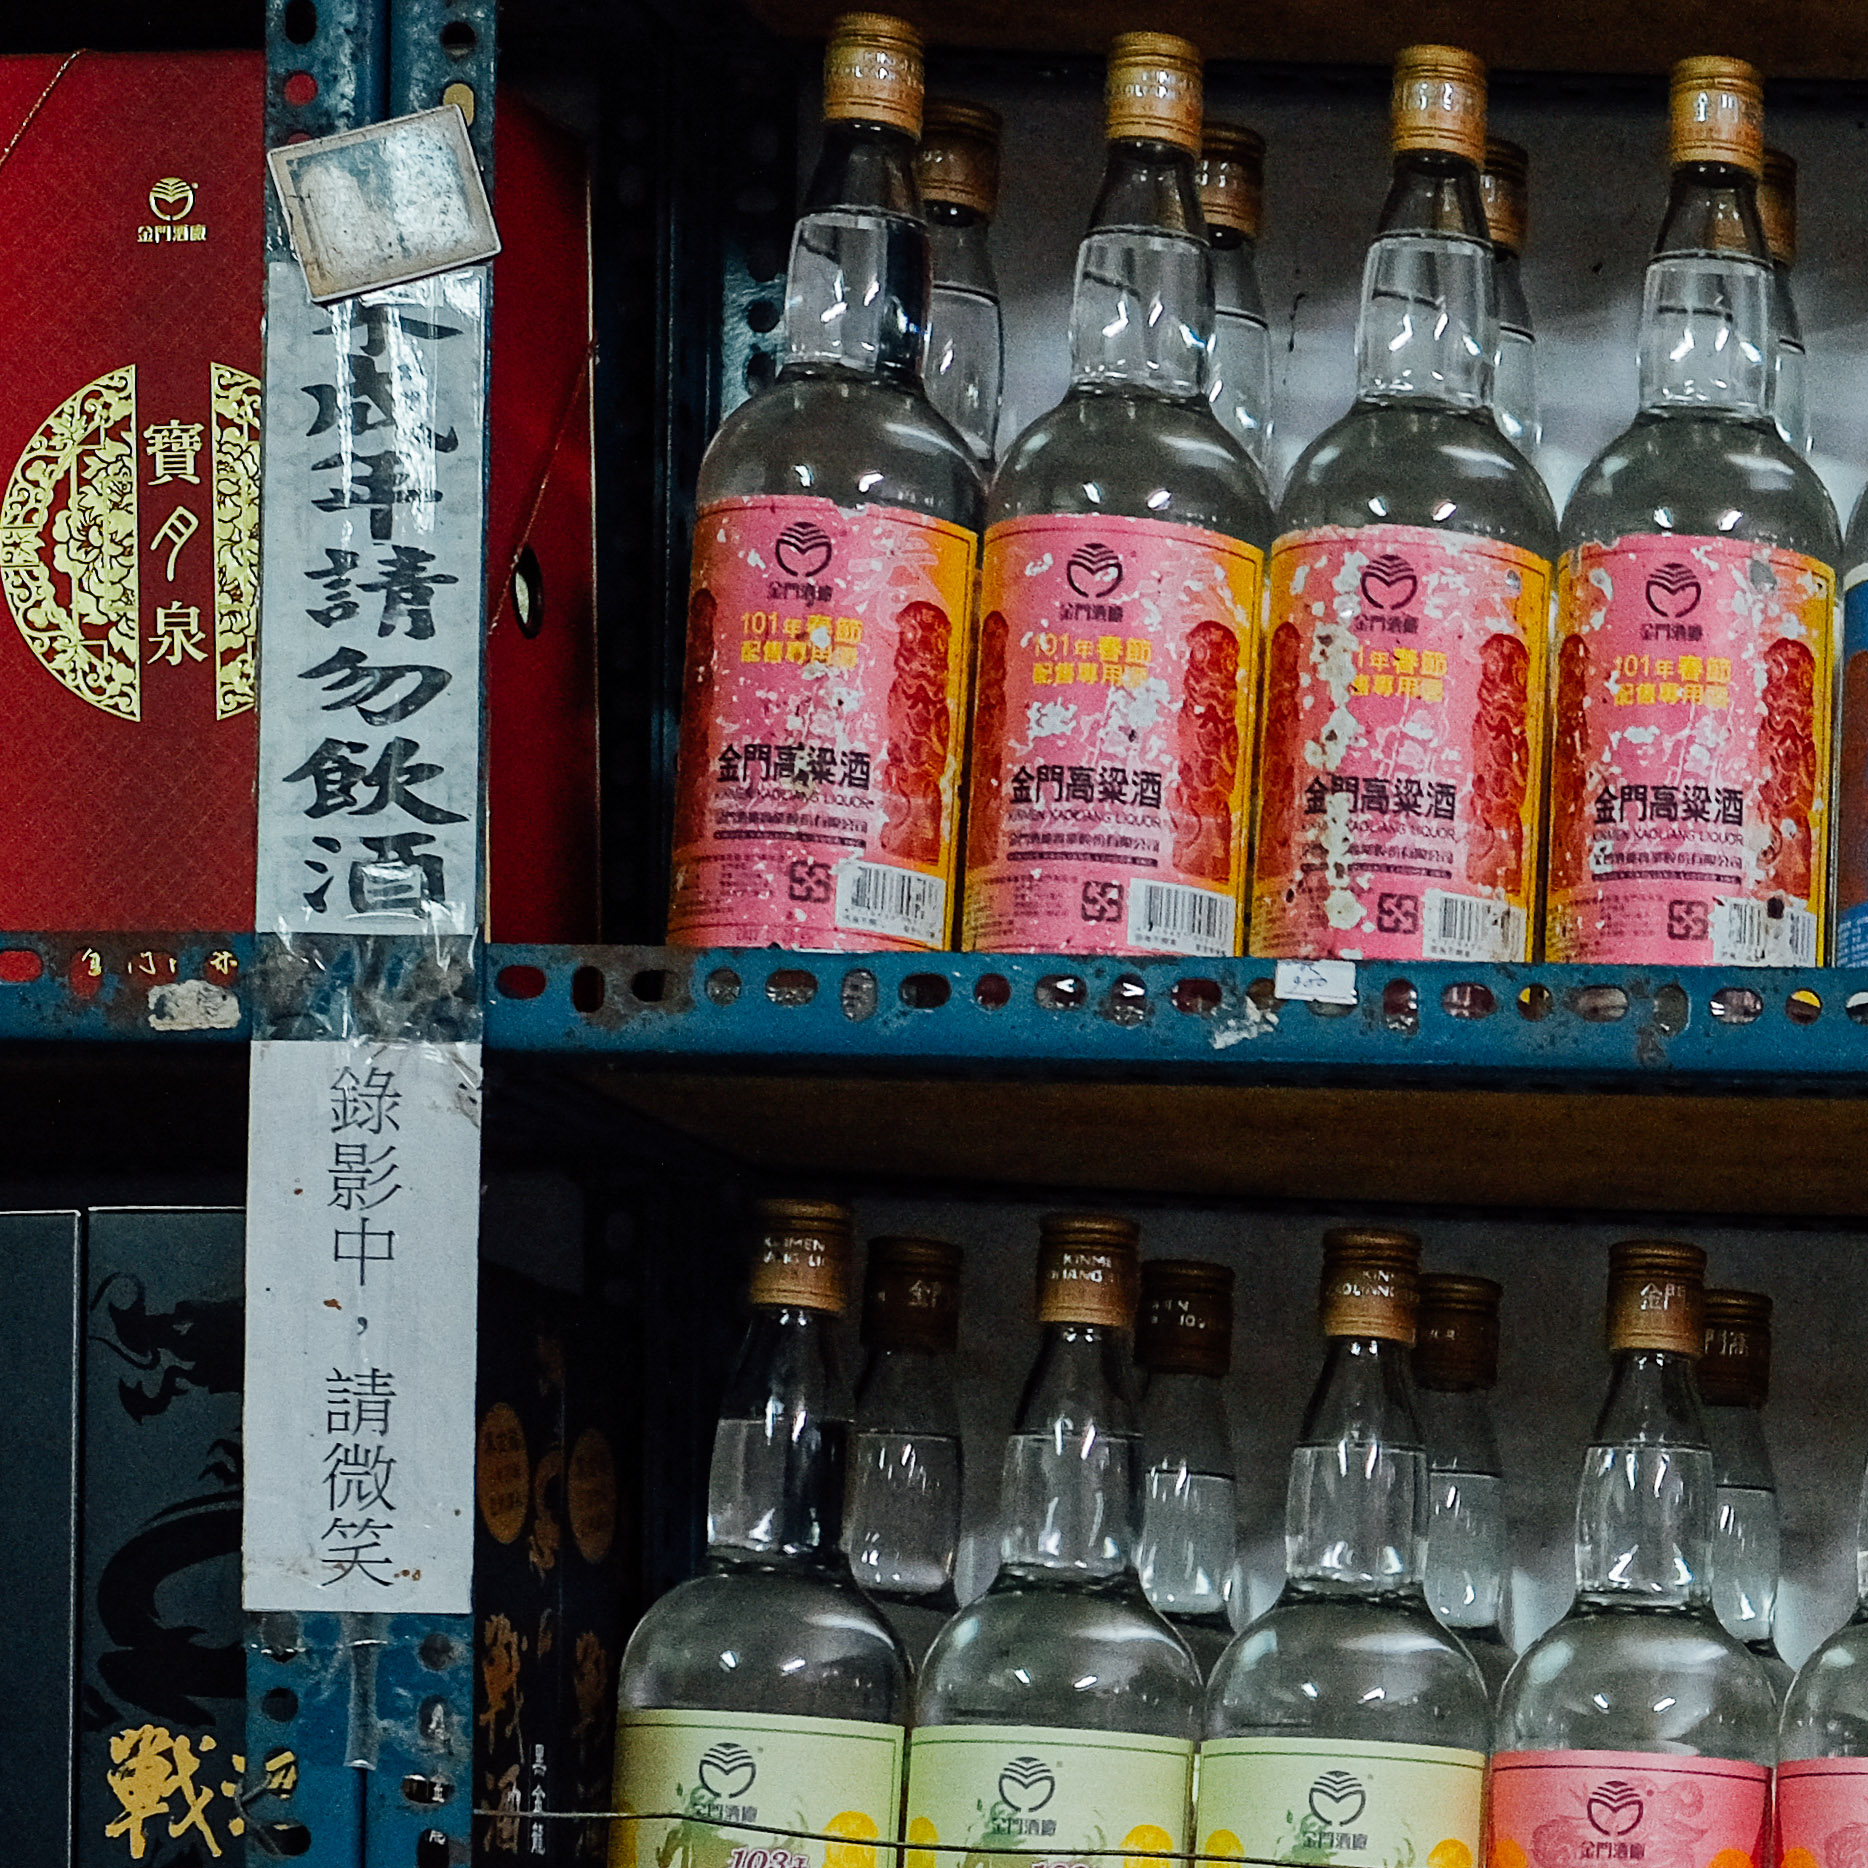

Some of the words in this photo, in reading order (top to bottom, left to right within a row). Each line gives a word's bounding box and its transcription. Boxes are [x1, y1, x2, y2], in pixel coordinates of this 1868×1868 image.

[1010, 766, 1162, 808] 金門高粱酒
[1594, 786, 1743, 827] 金門高粱酒
